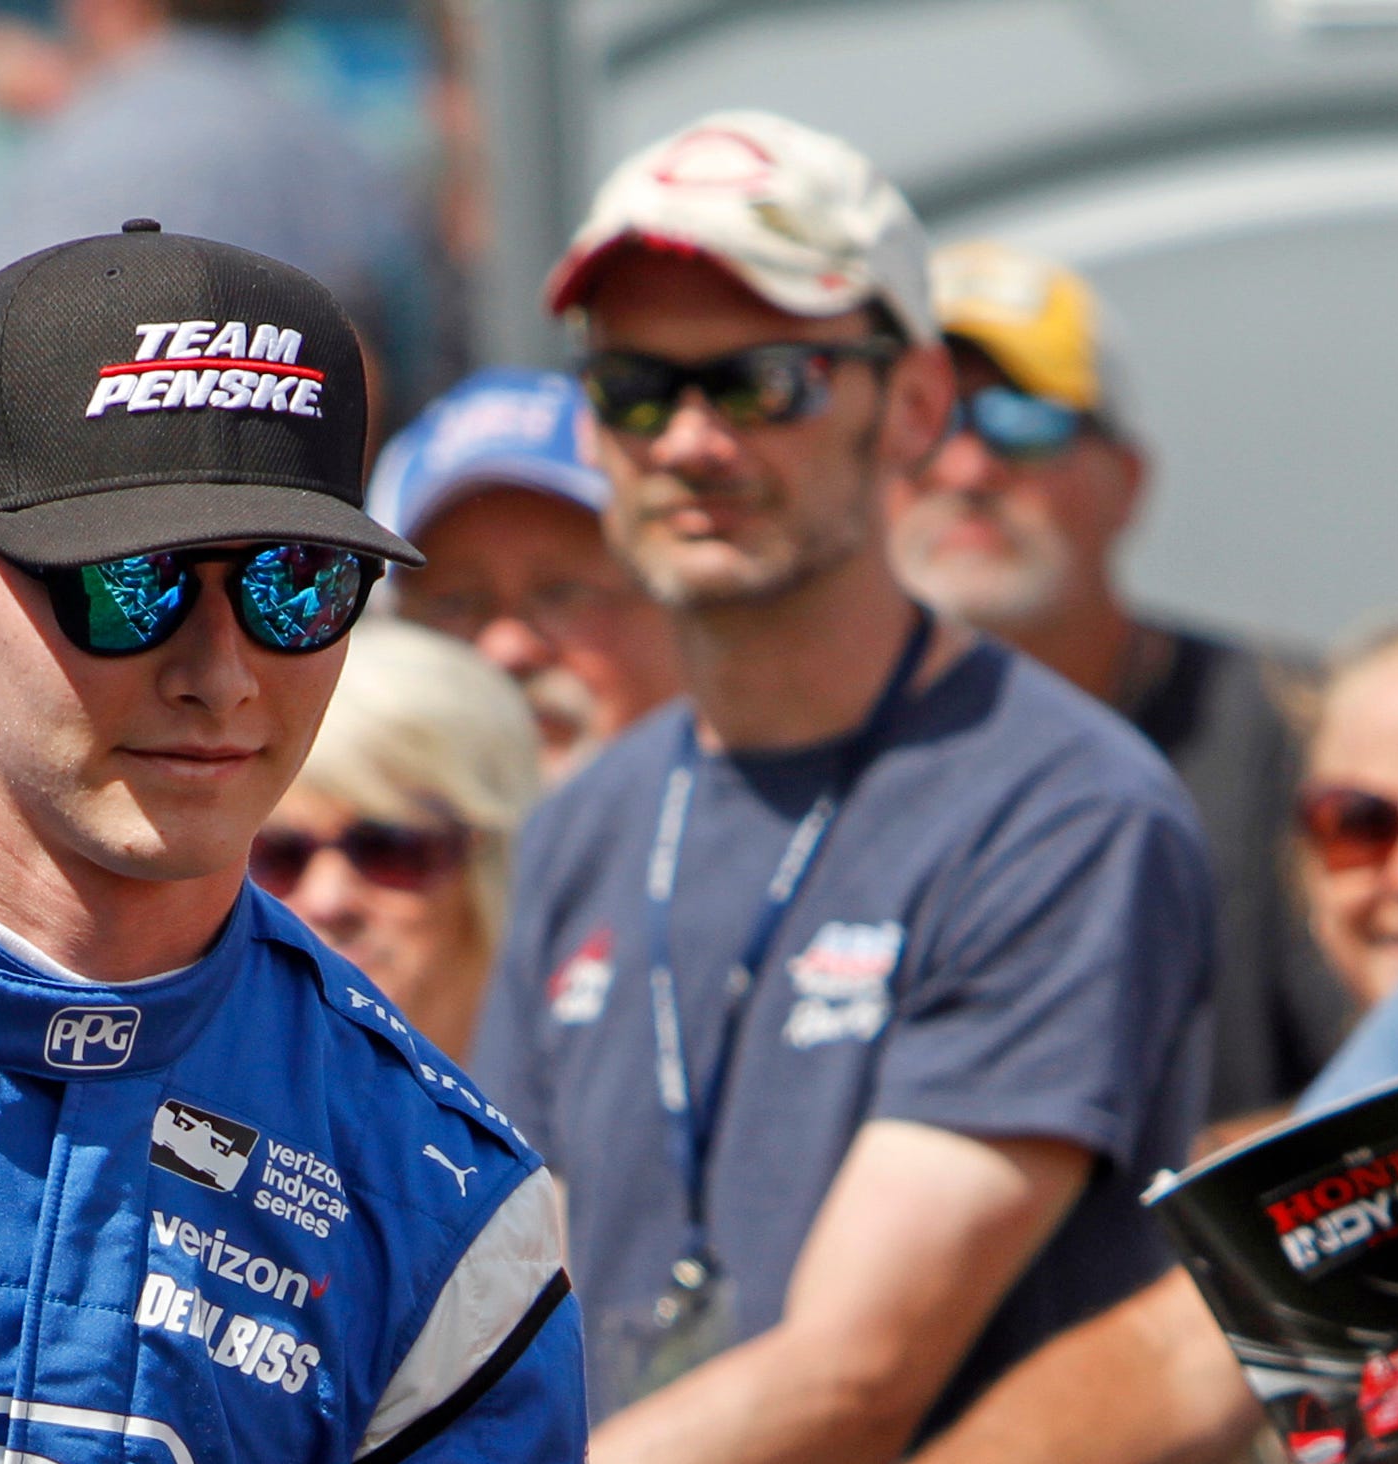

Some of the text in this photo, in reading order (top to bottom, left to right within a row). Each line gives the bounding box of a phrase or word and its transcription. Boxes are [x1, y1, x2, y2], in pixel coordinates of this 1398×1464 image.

[135, 320, 302, 365] TEAM
[51, 1014, 133, 1061] PPG
[346, 986, 530, 1149] Firstone
[253, 1188, 331, 1239] series
[261, 1161, 351, 1222] indycar
[152, 1211, 310, 1309] verizon
[1278, 1190, 1395, 1272] INDY
